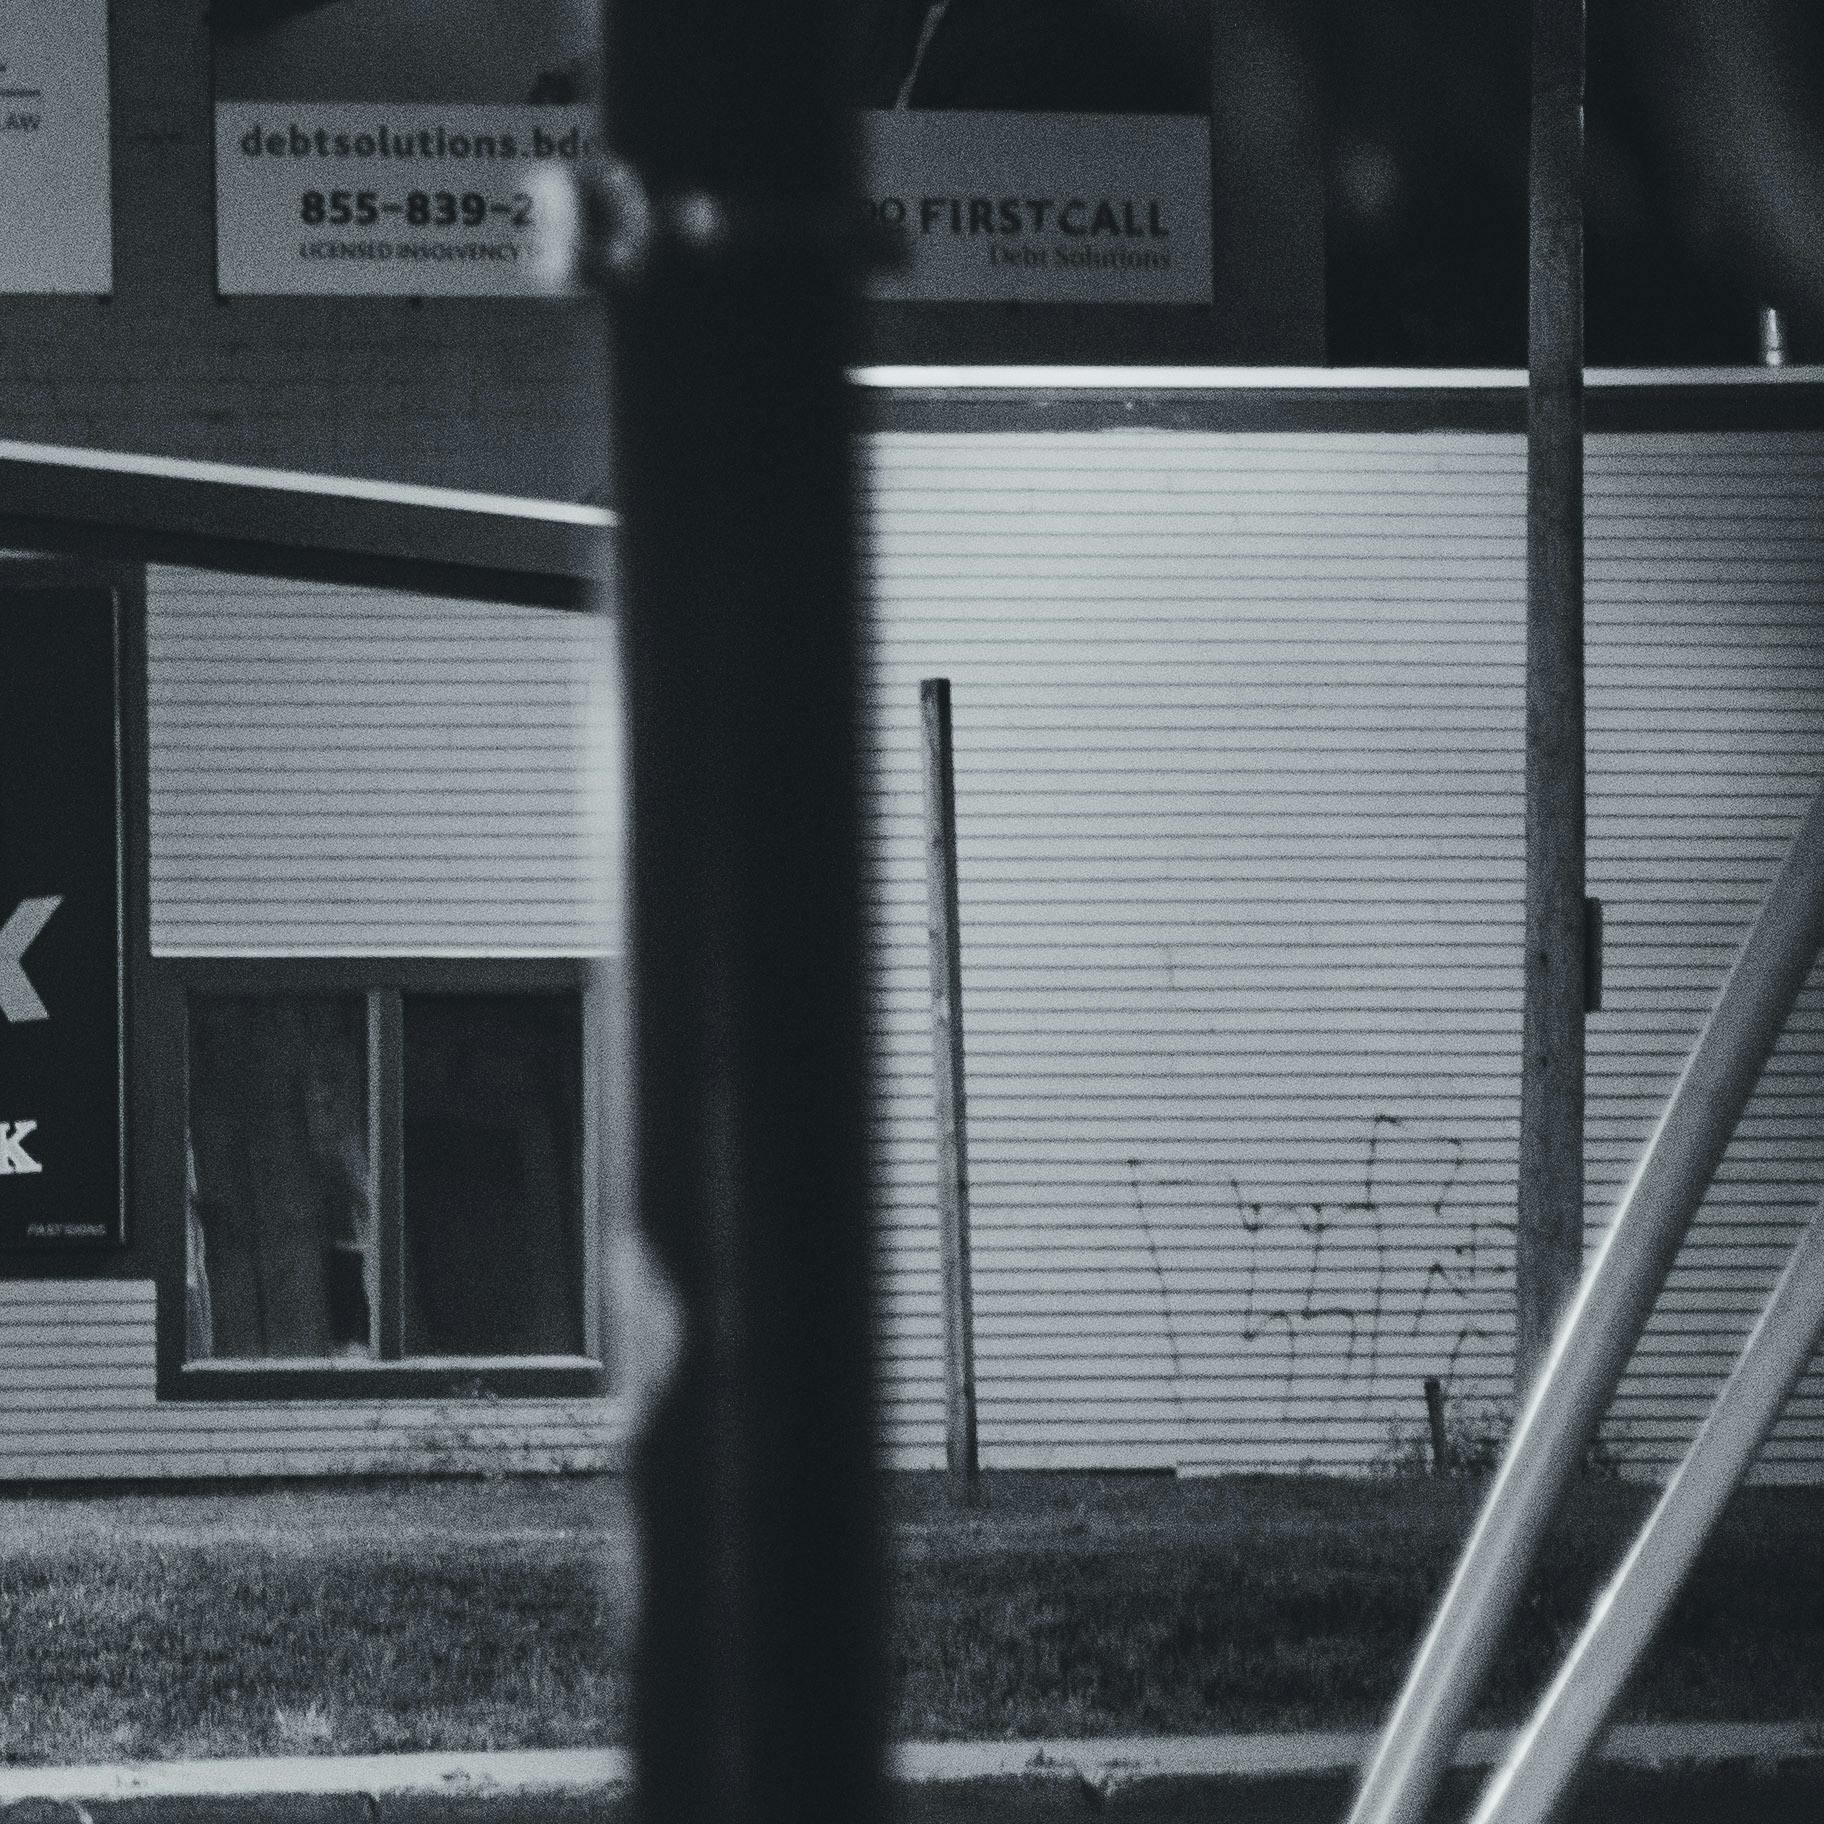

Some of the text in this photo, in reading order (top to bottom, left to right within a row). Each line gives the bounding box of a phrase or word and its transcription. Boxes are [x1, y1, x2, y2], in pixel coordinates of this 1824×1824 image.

[301, 190, 533, 226] 855-839-2
[299, 242, 520, 261] LICENSED INSOLVENCY
[989, 245, 1172, 270] Debt Solutions
